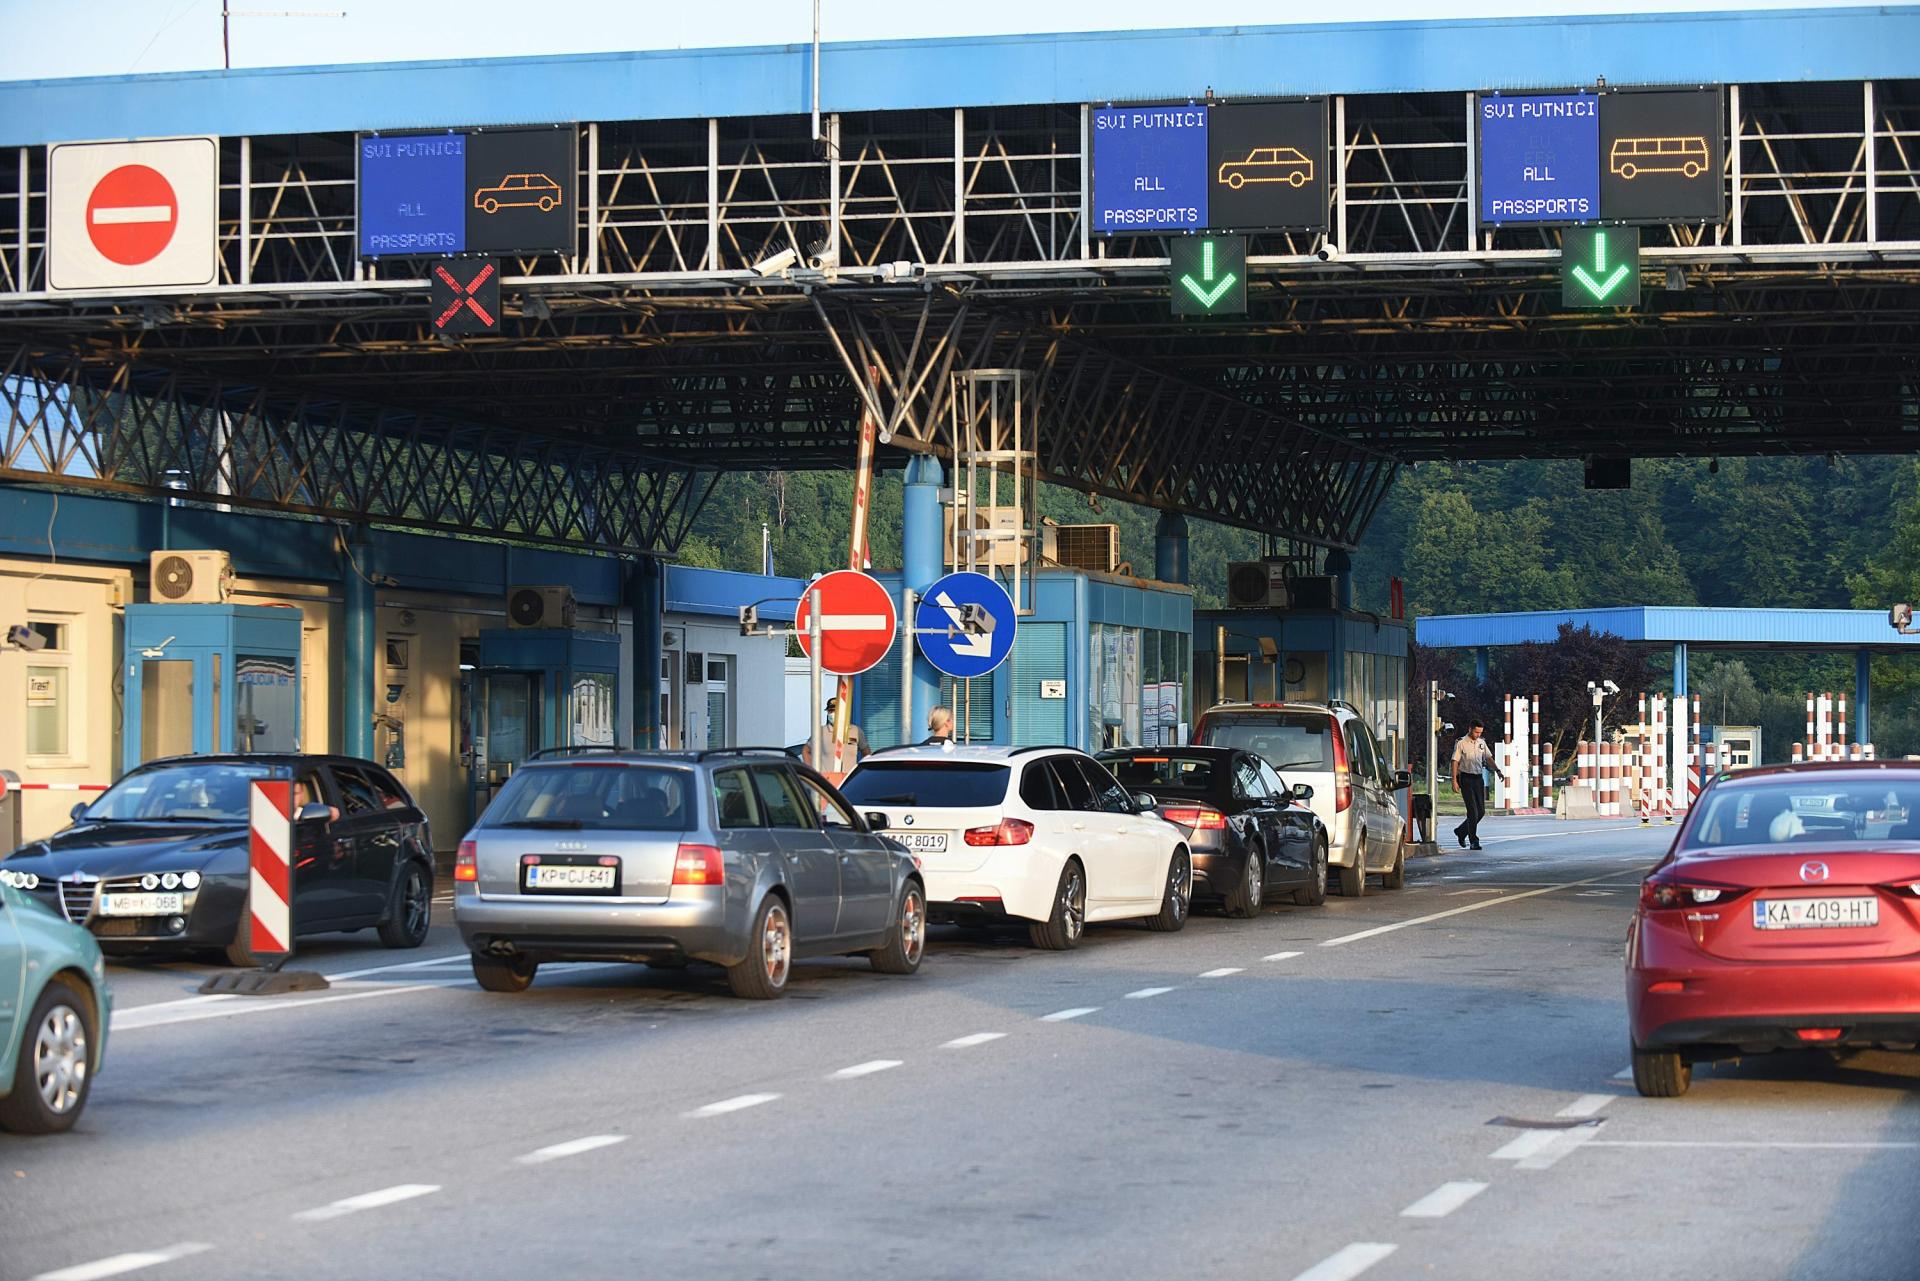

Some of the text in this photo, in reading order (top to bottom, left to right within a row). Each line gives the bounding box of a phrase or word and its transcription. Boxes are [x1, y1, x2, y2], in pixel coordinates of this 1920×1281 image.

[1484, 101, 1595, 119] SVI PUTNICI
[1096, 112, 1204, 129] SVI PUTNICI
[397, 141, 463, 157] PUTNICI
[1523, 166, 1555, 181] ALL
[1134, 176, 1165, 191] ALL
[398, 202, 427, 217] ALL
[1492, 198, 1589, 215] PASSPORTS
[1104, 207, 1198, 224] PASSPORTS
[369, 232, 456, 249] PASSPORTS
[915, 835, 945, 847] 8019
[540, 869, 609, 884] KP CJ-641
[1768, 900, 1873, 923] KA 409-HT
